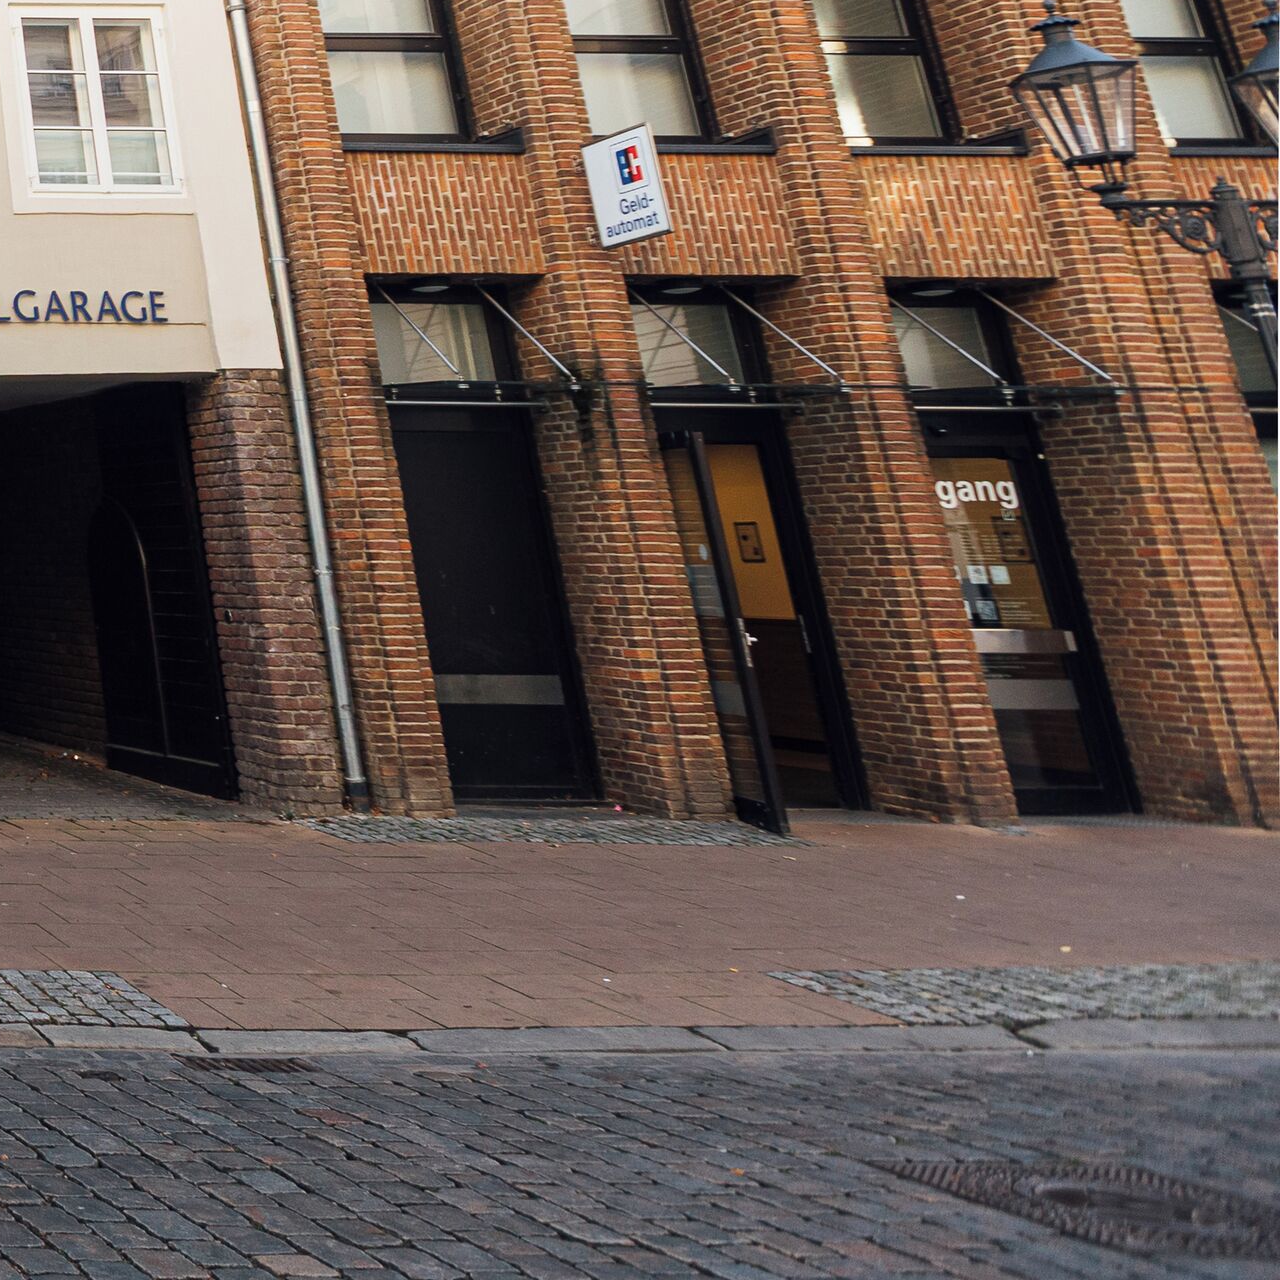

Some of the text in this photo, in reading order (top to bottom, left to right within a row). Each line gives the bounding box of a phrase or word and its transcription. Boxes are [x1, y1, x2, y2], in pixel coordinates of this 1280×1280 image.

[619, 192, 655, 215] Geld-
[606, 211, 660, 238] automat
[934, 480, 1019, 509] gang
